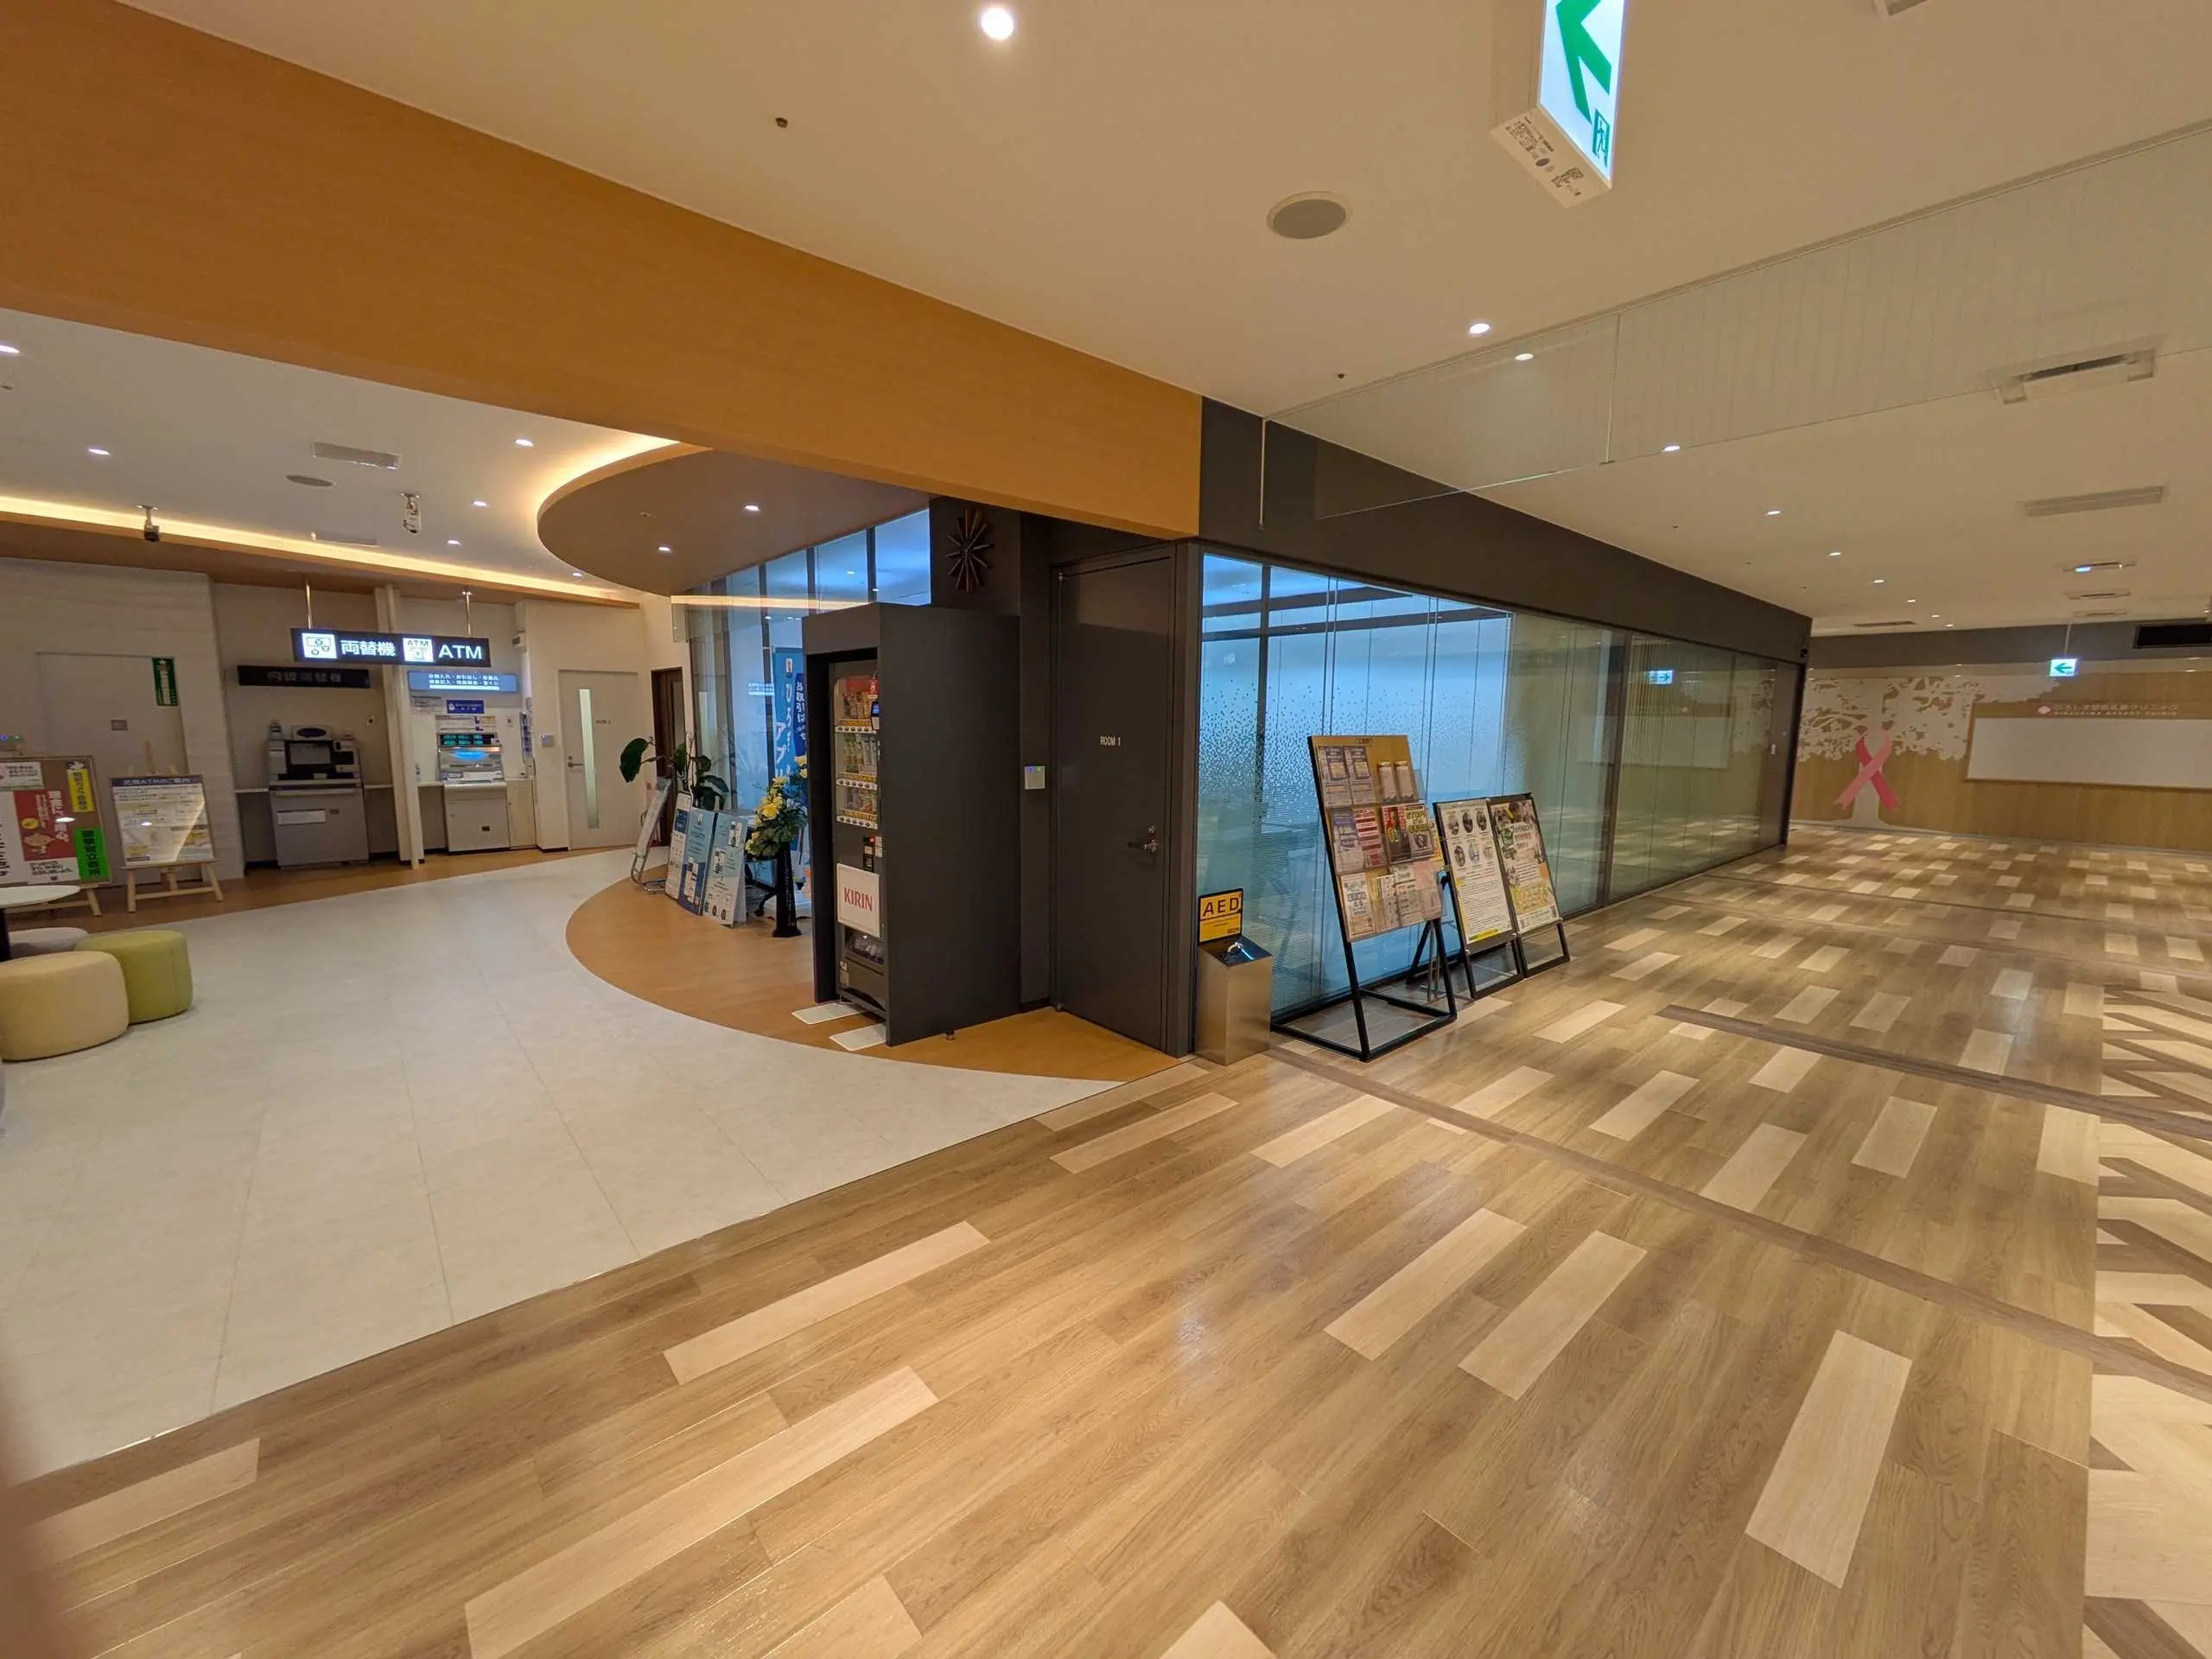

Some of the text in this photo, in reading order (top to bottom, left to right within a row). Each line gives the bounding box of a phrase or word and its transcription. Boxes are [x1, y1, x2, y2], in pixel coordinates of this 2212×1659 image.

[340, 639, 396, 657] 両替機
[439, 645, 483, 660] ATM
[844, 887, 873, 912] KIRIN
[1203, 898, 1239, 916] AED
